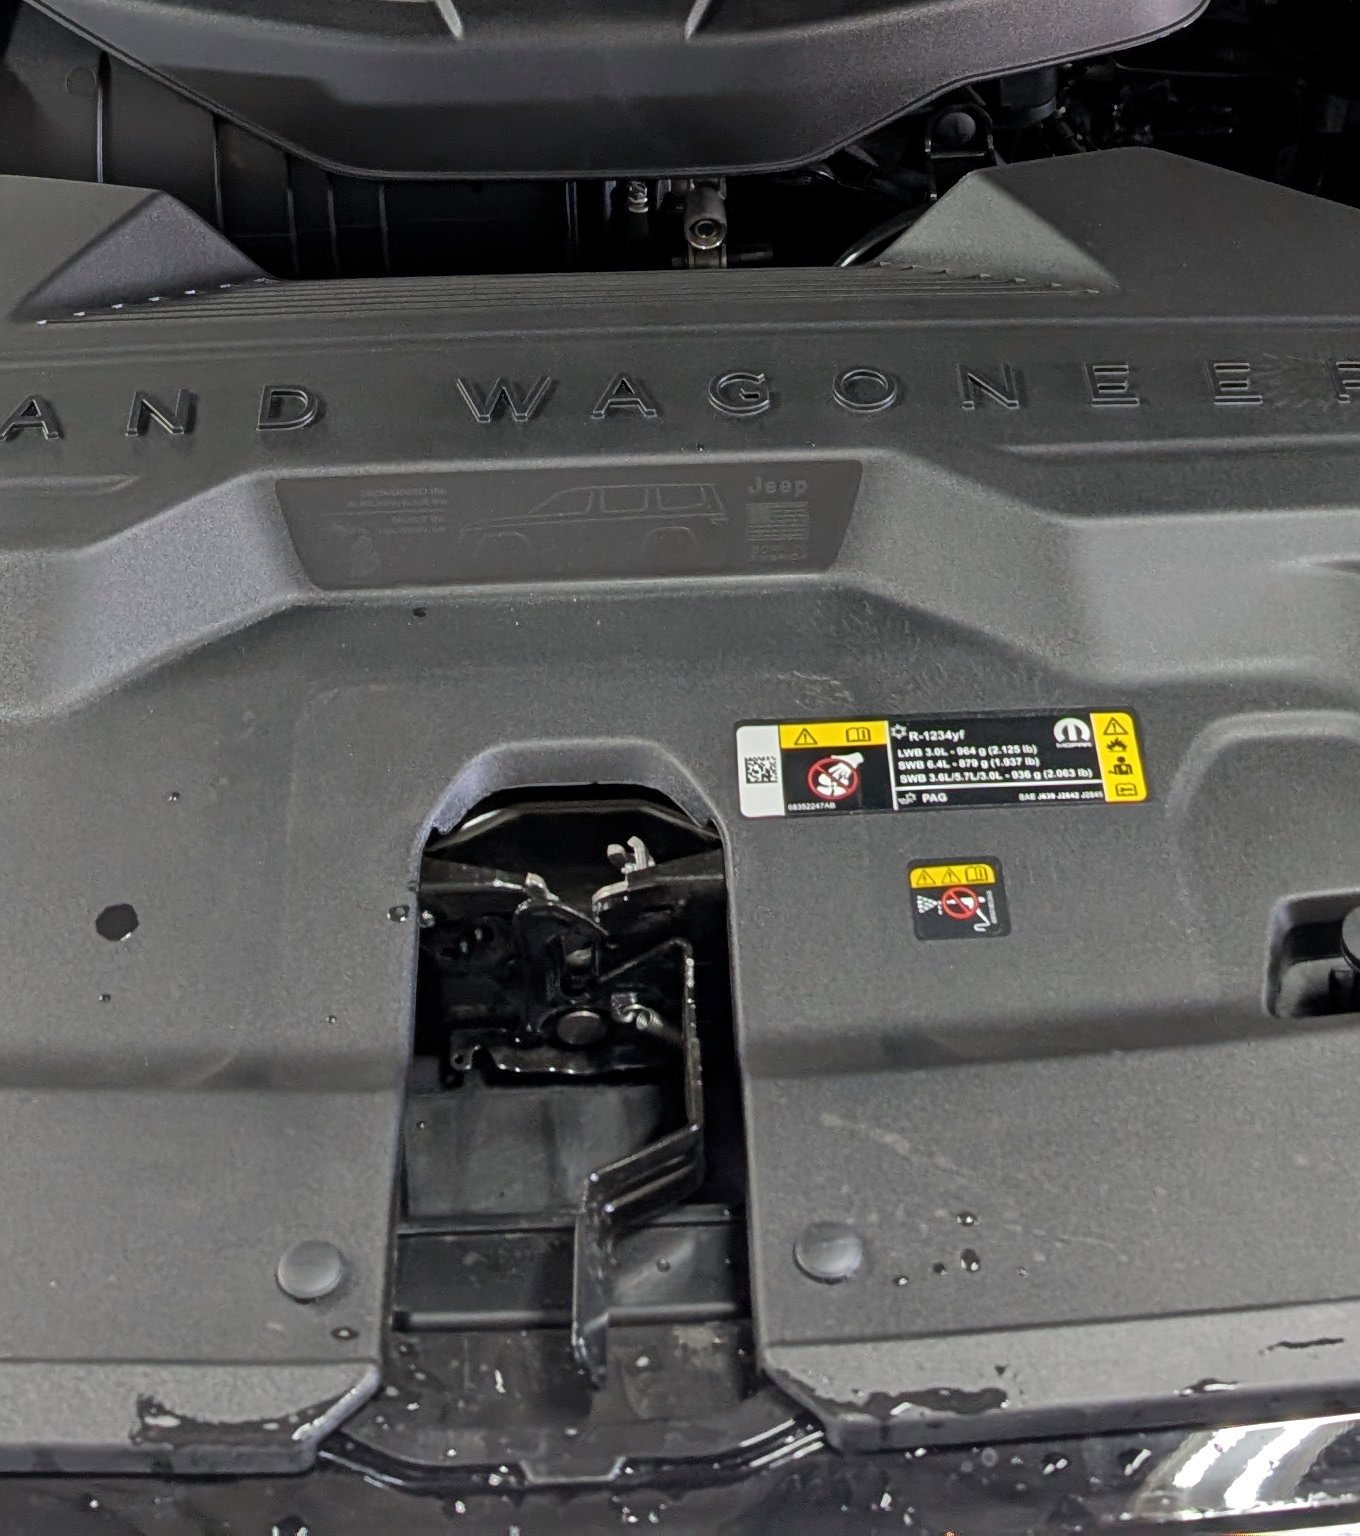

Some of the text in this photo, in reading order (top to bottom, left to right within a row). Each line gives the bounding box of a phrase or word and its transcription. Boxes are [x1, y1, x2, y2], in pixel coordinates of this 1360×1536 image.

[747, 476, 810, 498] Jeep
[908, 729, 966, 743] R-1234yf
[897, 747, 924, 758] LWB
[925, 747, 949, 757] 3.0L
[978, 747, 987, 757] g
[1022, 744, 1038, 755] lb)
[898, 760, 925, 770] SWB
[927, 759, 951, 769] 6.4L
[980, 759, 989, 769] g
[1024, 756, 1040, 768] lb)
[900, 773, 927, 784] SWB
[1033, 771, 1041, 780] g
[1077, 767, 1093, 778] lb)
[921, 792, 948, 803] PAG
